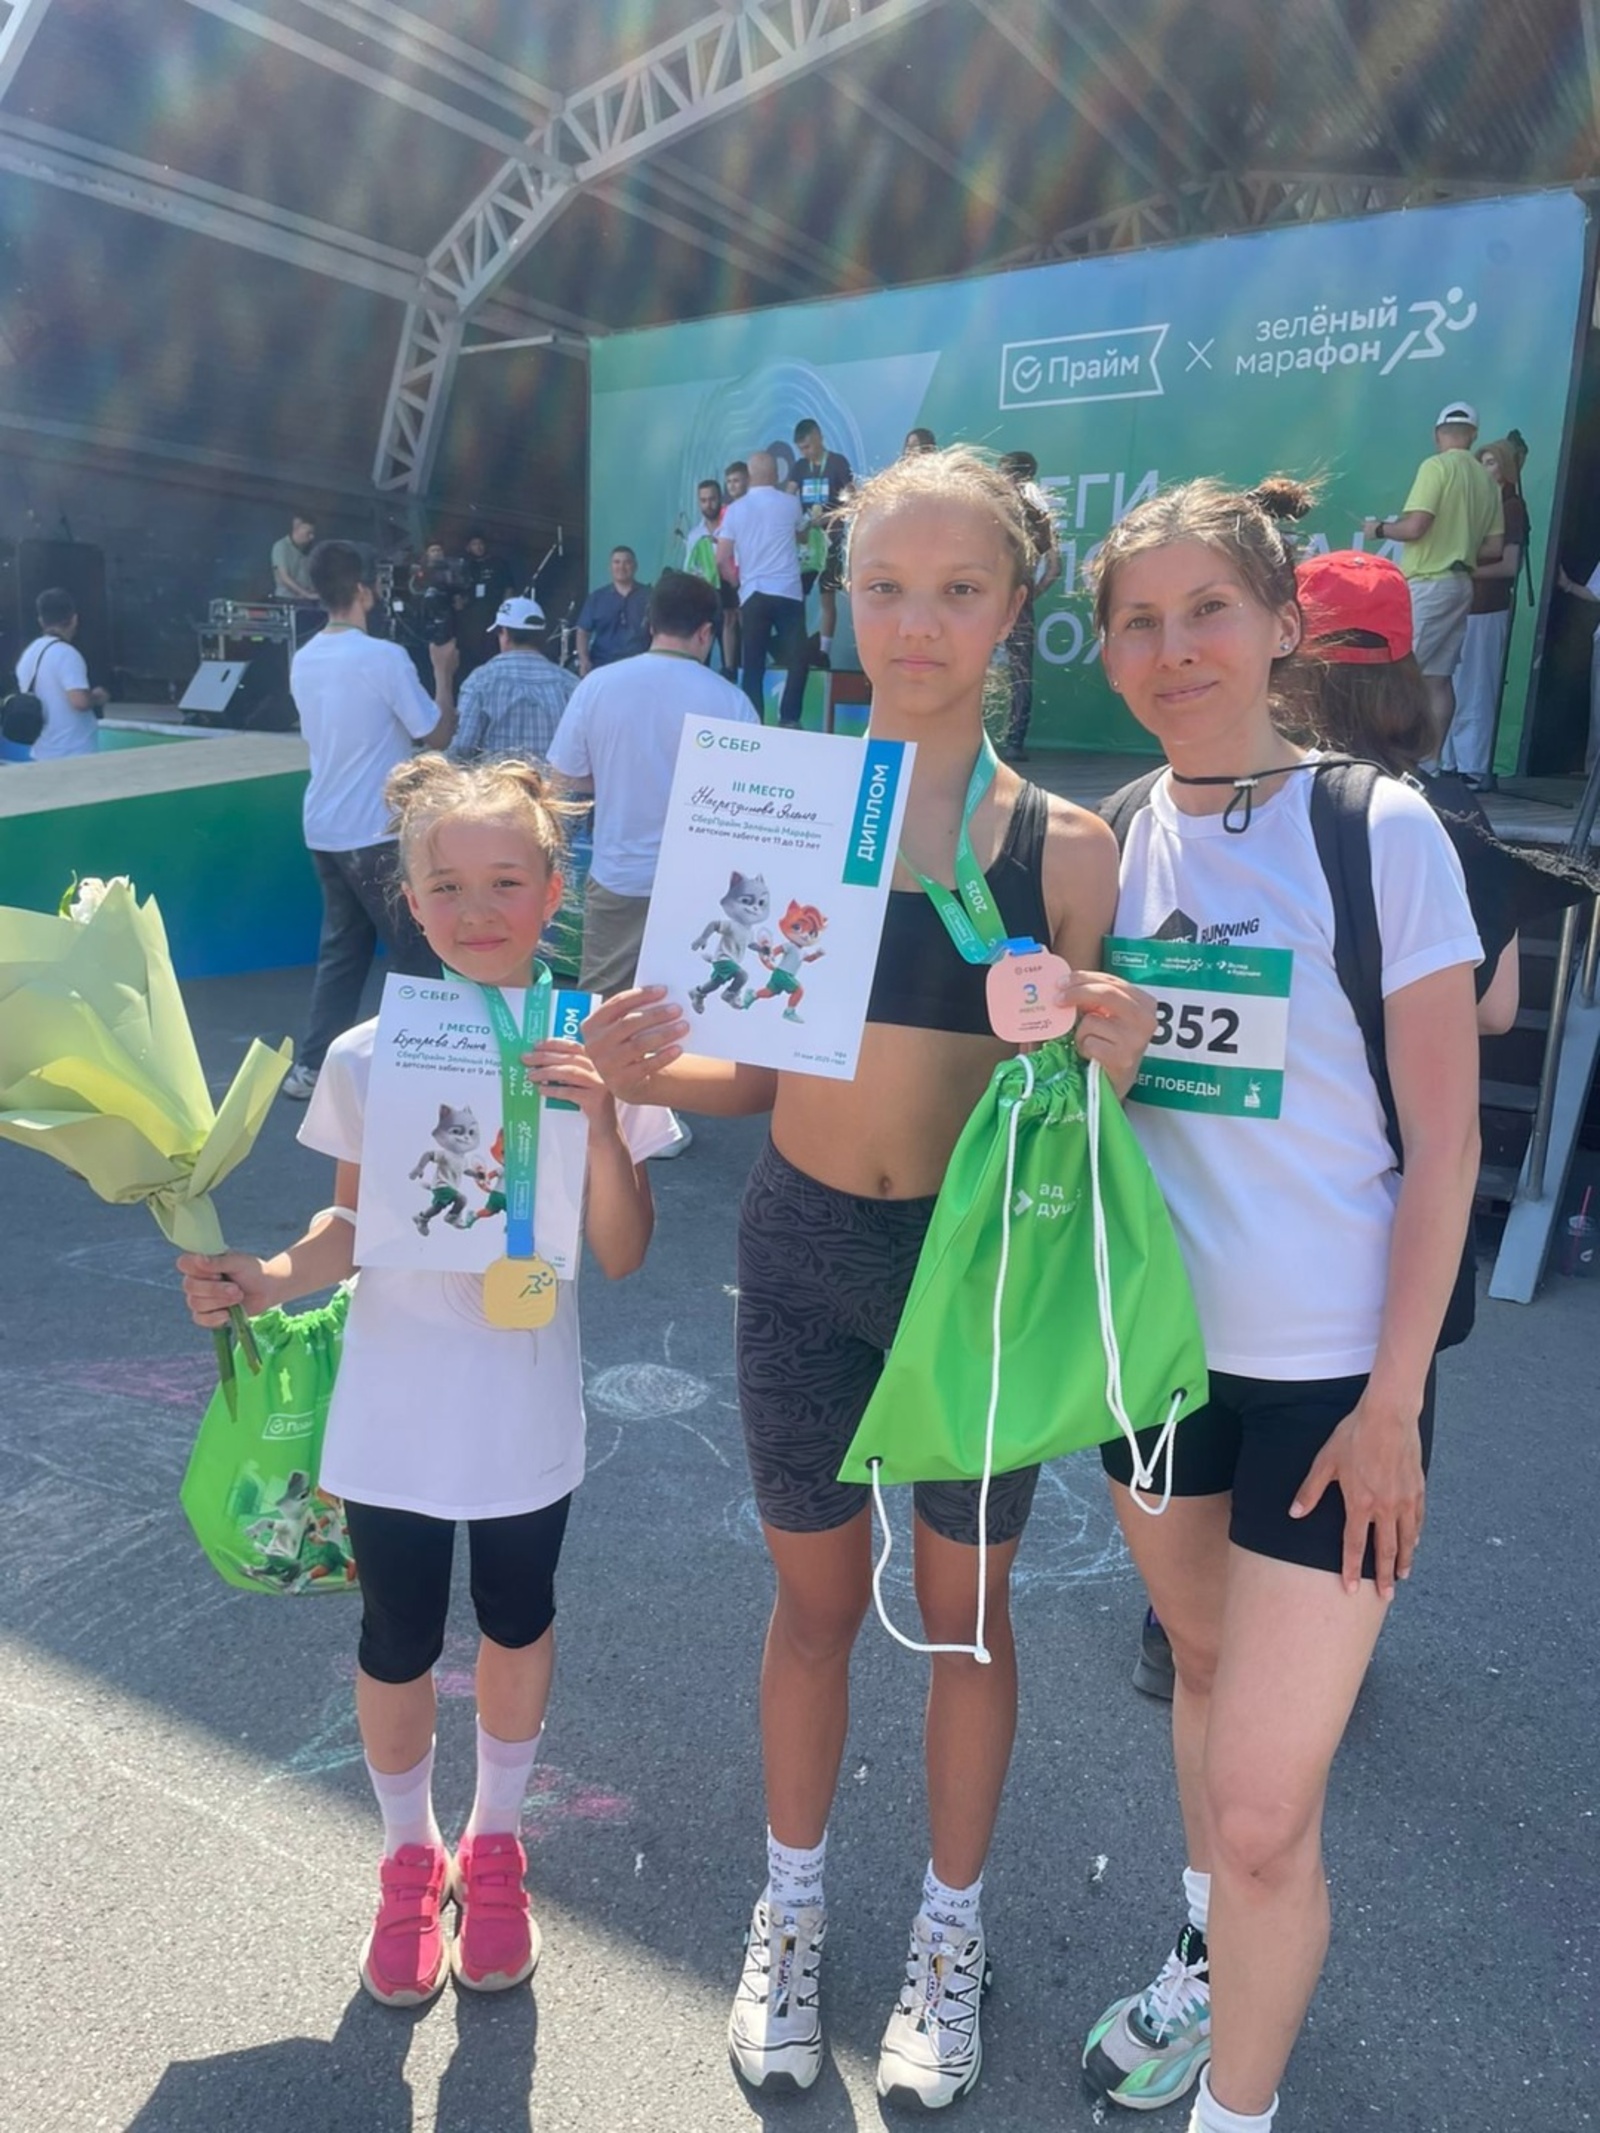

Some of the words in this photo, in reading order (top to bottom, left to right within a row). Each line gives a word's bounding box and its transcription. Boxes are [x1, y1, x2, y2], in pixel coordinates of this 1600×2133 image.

[1255, 295, 1398, 342] зелёный
[1048, 348, 1140, 388] Прайм
[1235, 336, 1381, 378] марафон
[1038, 468, 1160, 529] ЕГИ
[719, 737, 761, 753] СБЕР
[749, 783, 795, 800] МЕСТО
[857, 764, 889, 862] ДИПЛОМ
[965, 879, 988, 914] 2025
[1201, 917, 1260, 942] RUNNING
[420, 989, 460, 1002] СБЕР
[1023, 984, 1038, 1004] 3
[447, 1023, 491, 1035] МЕСТО
[1155, 1076, 1221, 1097] ПОБЕДЫ
